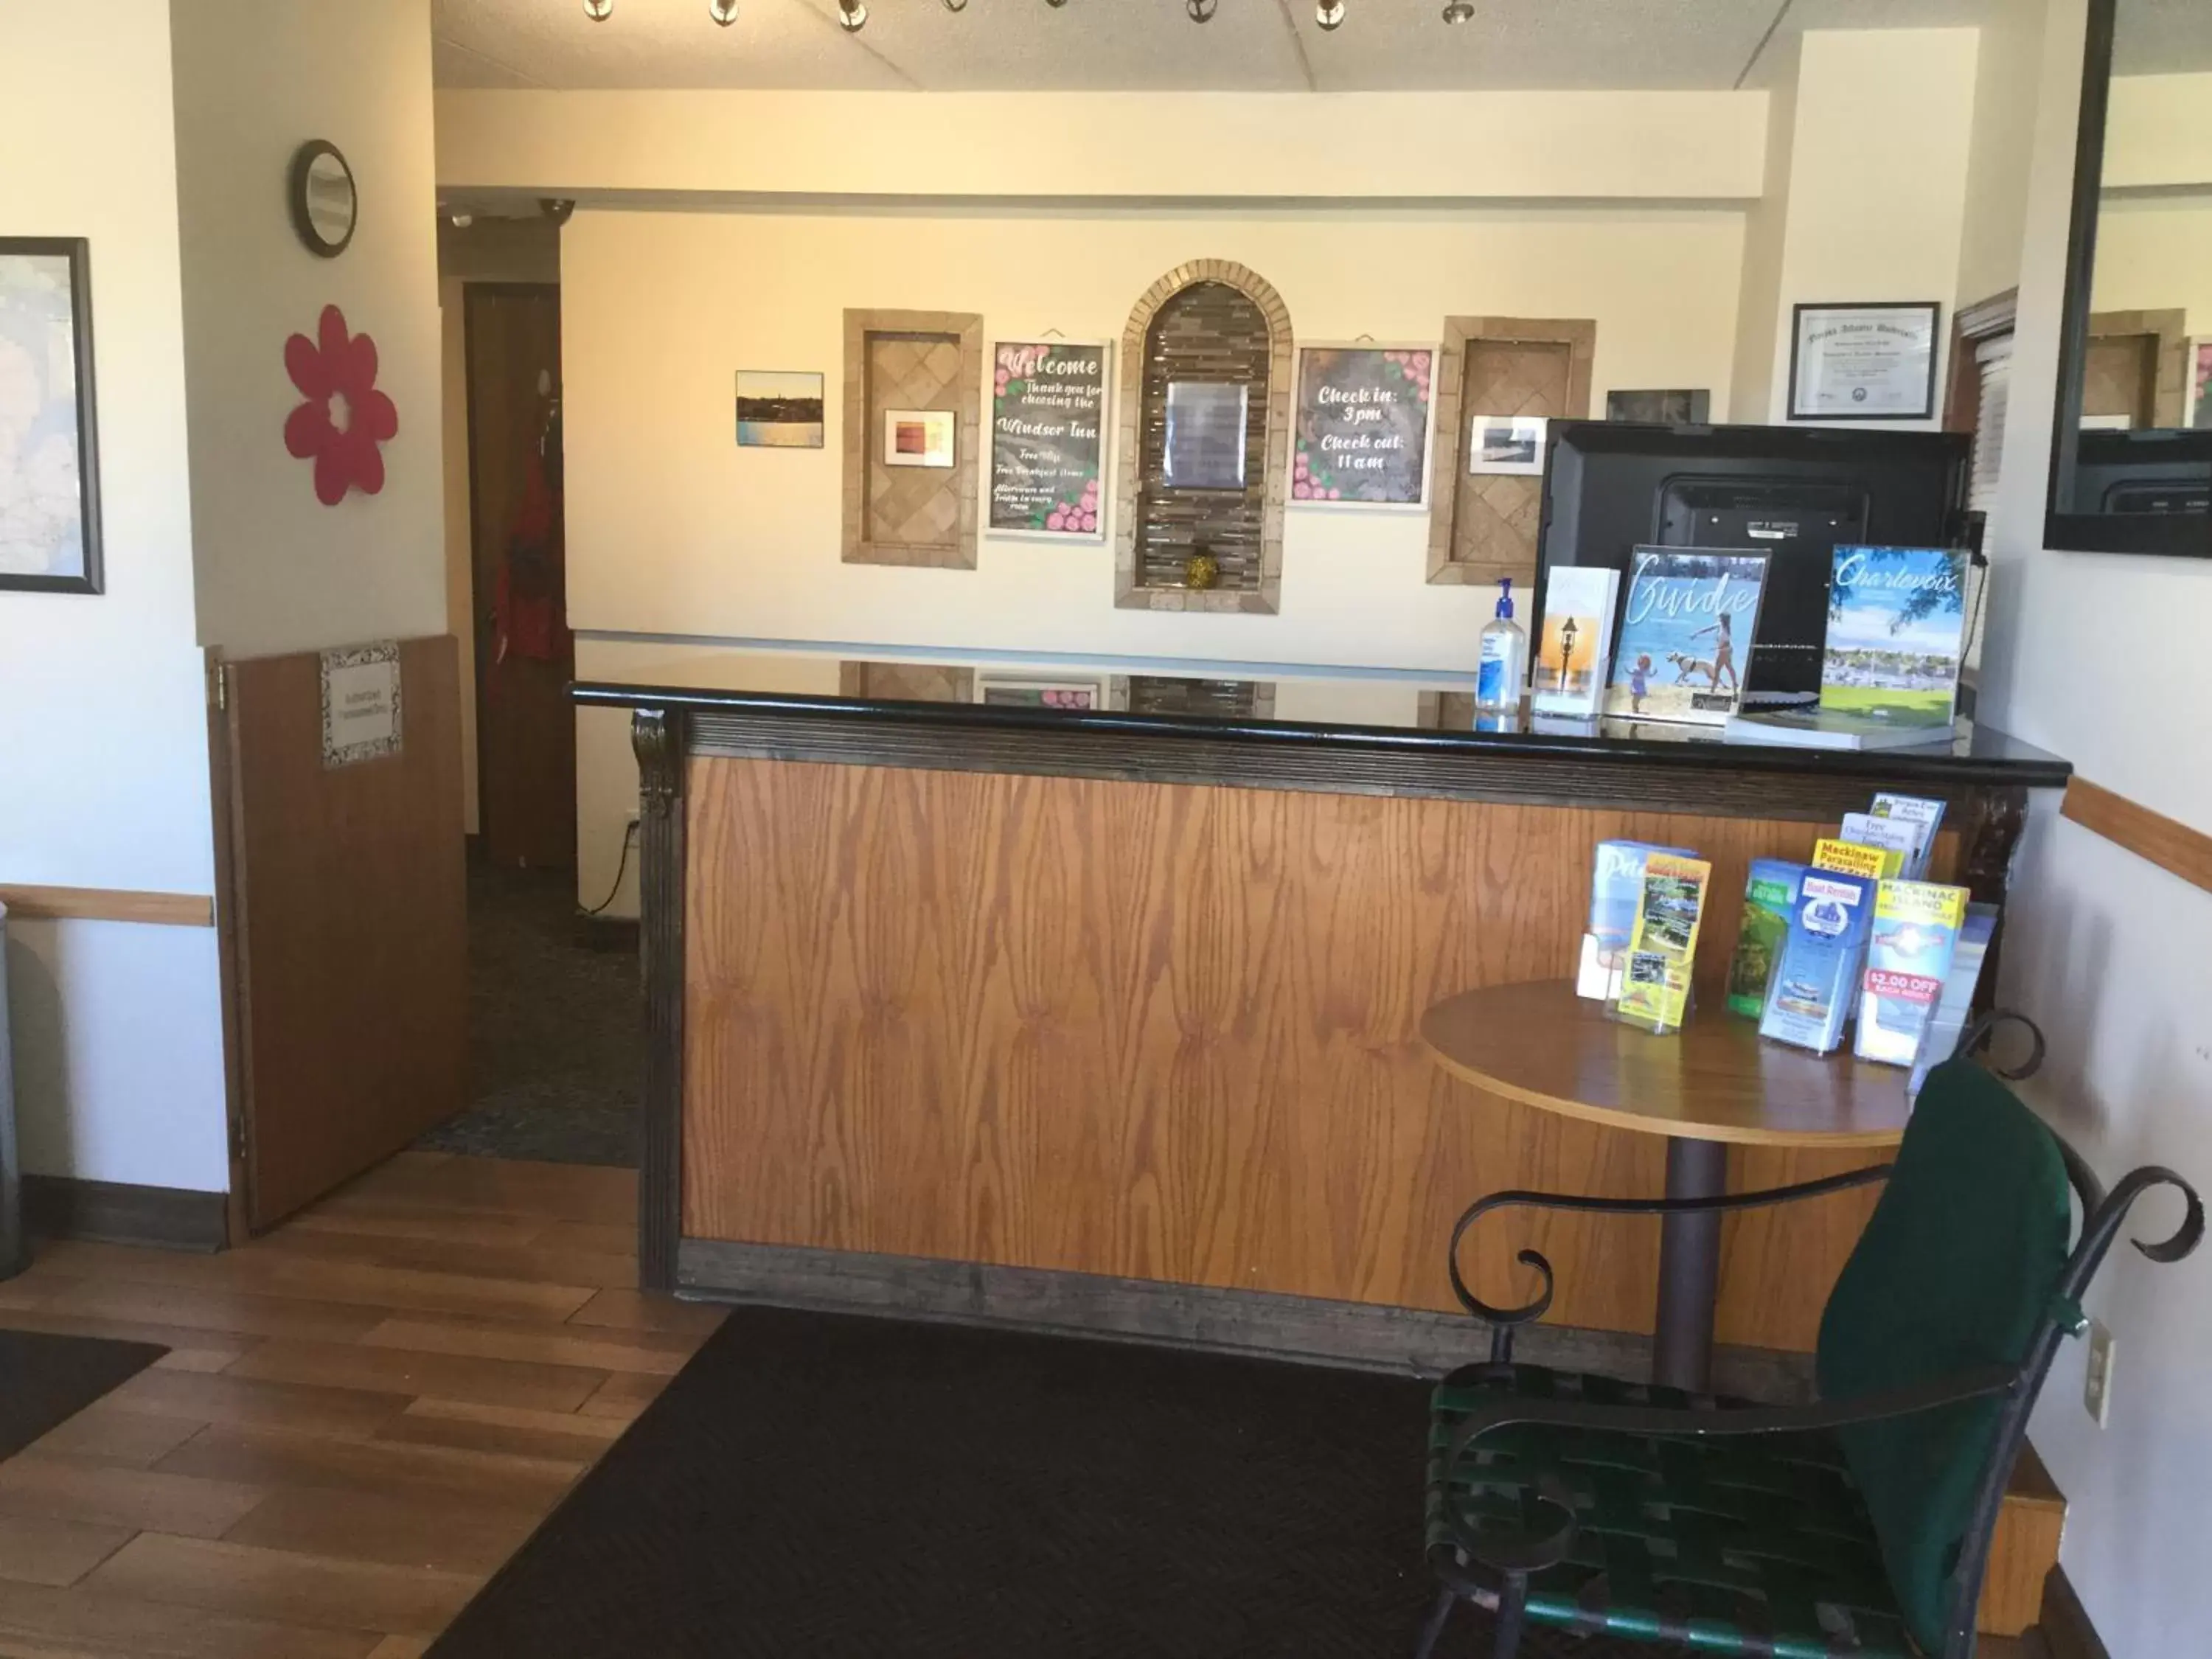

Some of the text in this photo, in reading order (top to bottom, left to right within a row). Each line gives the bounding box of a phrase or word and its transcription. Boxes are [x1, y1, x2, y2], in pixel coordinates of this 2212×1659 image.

[998, 352, 1099, 378] Welcome
[1023, 379, 1062, 394] Thank
[1064, 385, 1085, 396] you
[1318, 385, 1397, 405] Check in:
[1021, 394, 1095, 409] choosing the
[997, 417, 1097, 439] Windsor Inn
[1321, 434, 1370, 451] Check
[1836, 553, 1958, 590] Charlevoix
[1625, 554, 1758, 625] Guide
[1821, 842, 1879, 862] Mackinaw
[1820, 852, 1877, 874] Parasailing
[1882, 882, 1956, 902] MACKINAC
[1871, 972, 1939, 993] $2.00 OFF
